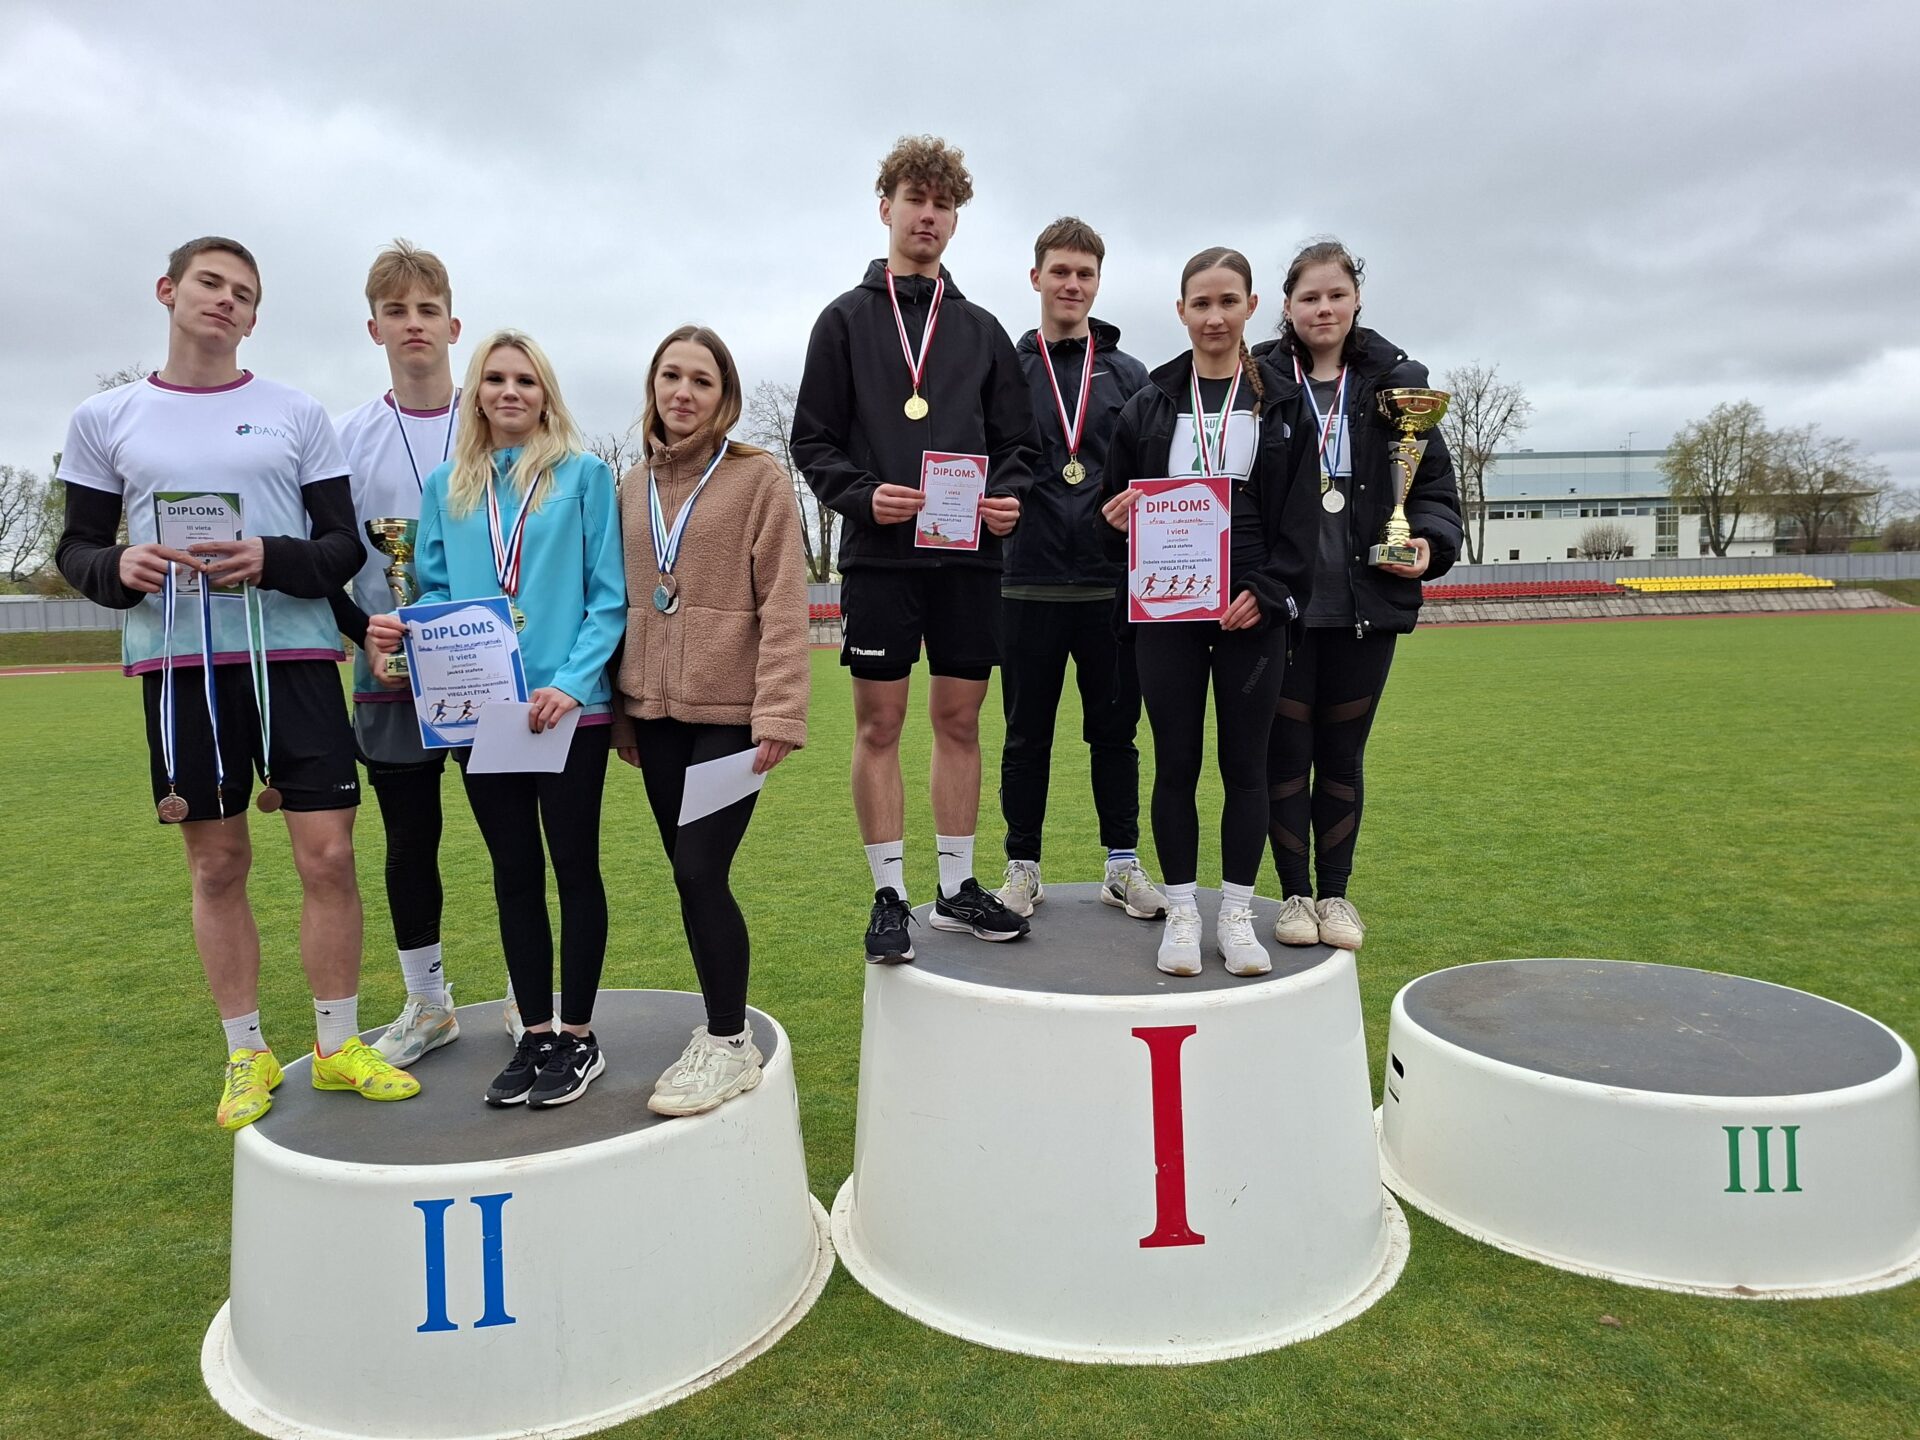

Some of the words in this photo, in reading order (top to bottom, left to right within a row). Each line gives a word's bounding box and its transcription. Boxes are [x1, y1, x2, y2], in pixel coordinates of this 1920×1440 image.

[933, 467, 976, 478] DIPLOMS
[168, 506, 224, 516] DIPLOMS
[1146, 499, 1210, 513] DIPLOMS
[421, 621, 495, 641] DIPLOMS
[456, 653, 477, 661] vieta
[856, 647, 885, 656] hummel
[447, 689, 490, 697] VIEGLATLĒTIKĀ
[1131, 1025, 1206, 1248] I
[1722, 1125, 1803, 1193] III
[413, 1192, 517, 1333] II
